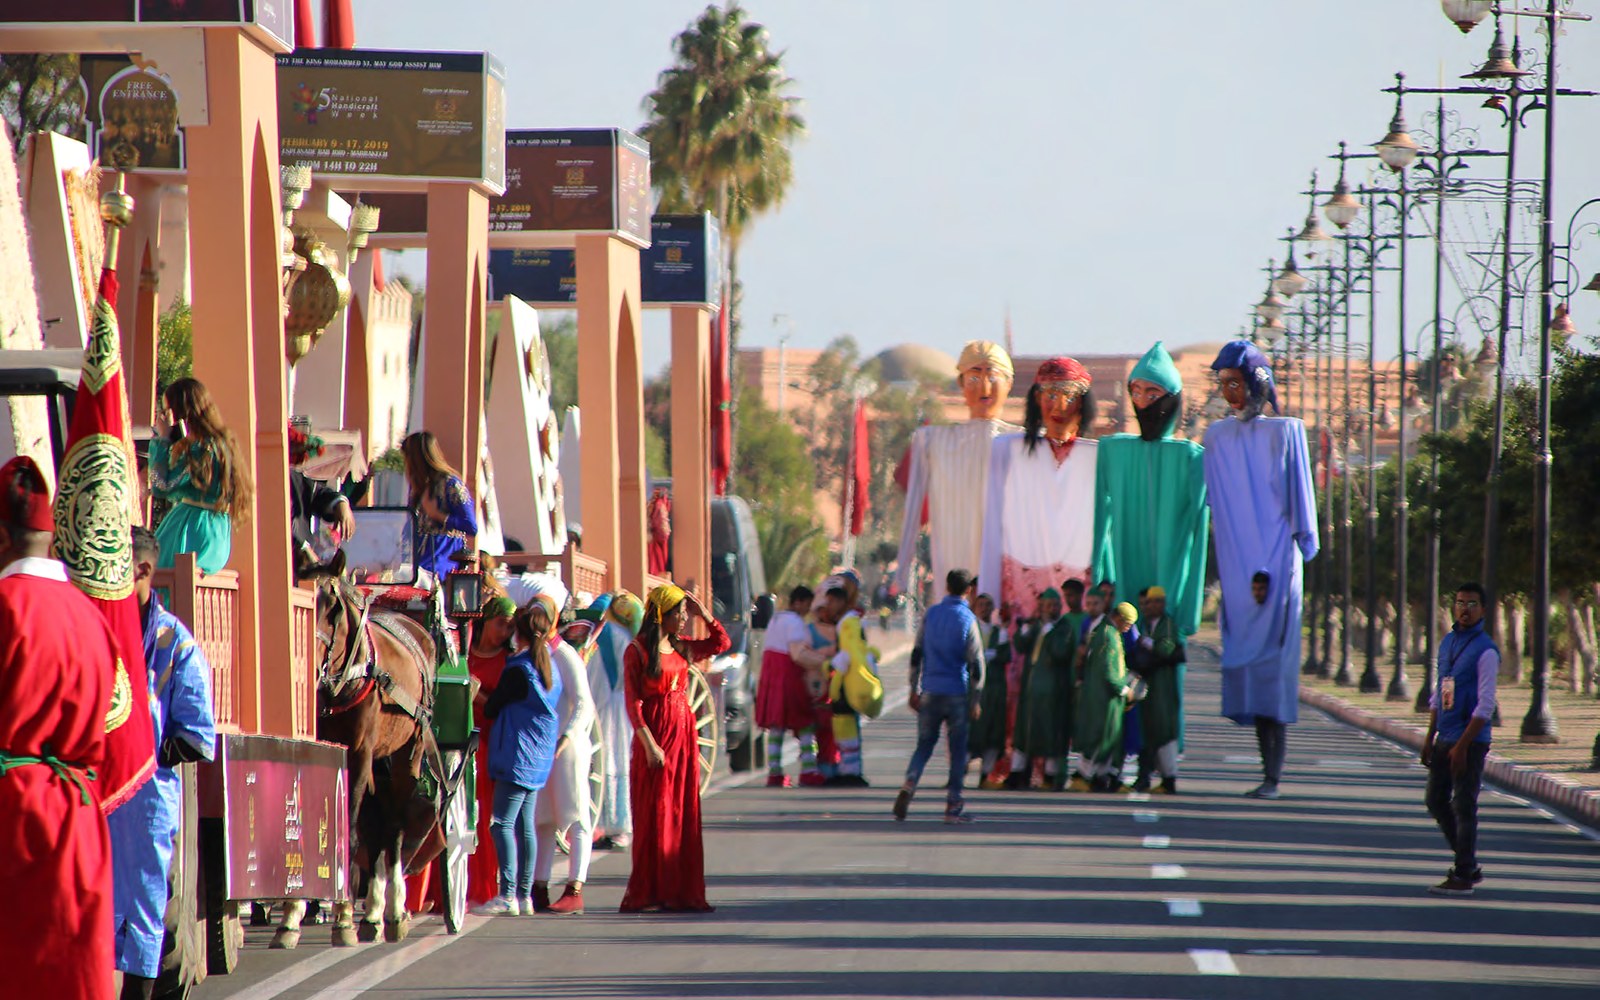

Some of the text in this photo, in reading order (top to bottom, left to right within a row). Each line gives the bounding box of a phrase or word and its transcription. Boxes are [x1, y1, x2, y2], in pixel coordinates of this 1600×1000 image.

[305, 58, 322, 66] KING
[324, 59, 362, 67] MOHAMMED
[405, 61, 427, 69] ASSIST
[126, 81, 153, 90] FREE
[112, 89, 168, 99] ENTRANCE
[331, 94, 378, 102] National
[331, 102, 378, 110] Handicraft
[332, 110, 378, 119] Week
[281, 138, 329, 148] FEBRUARY
[364, 140, 389, 150] 2019
[323, 160, 342, 171] 14H
[344, 161, 357, 171] TO
[358, 162, 378, 172] 22H
